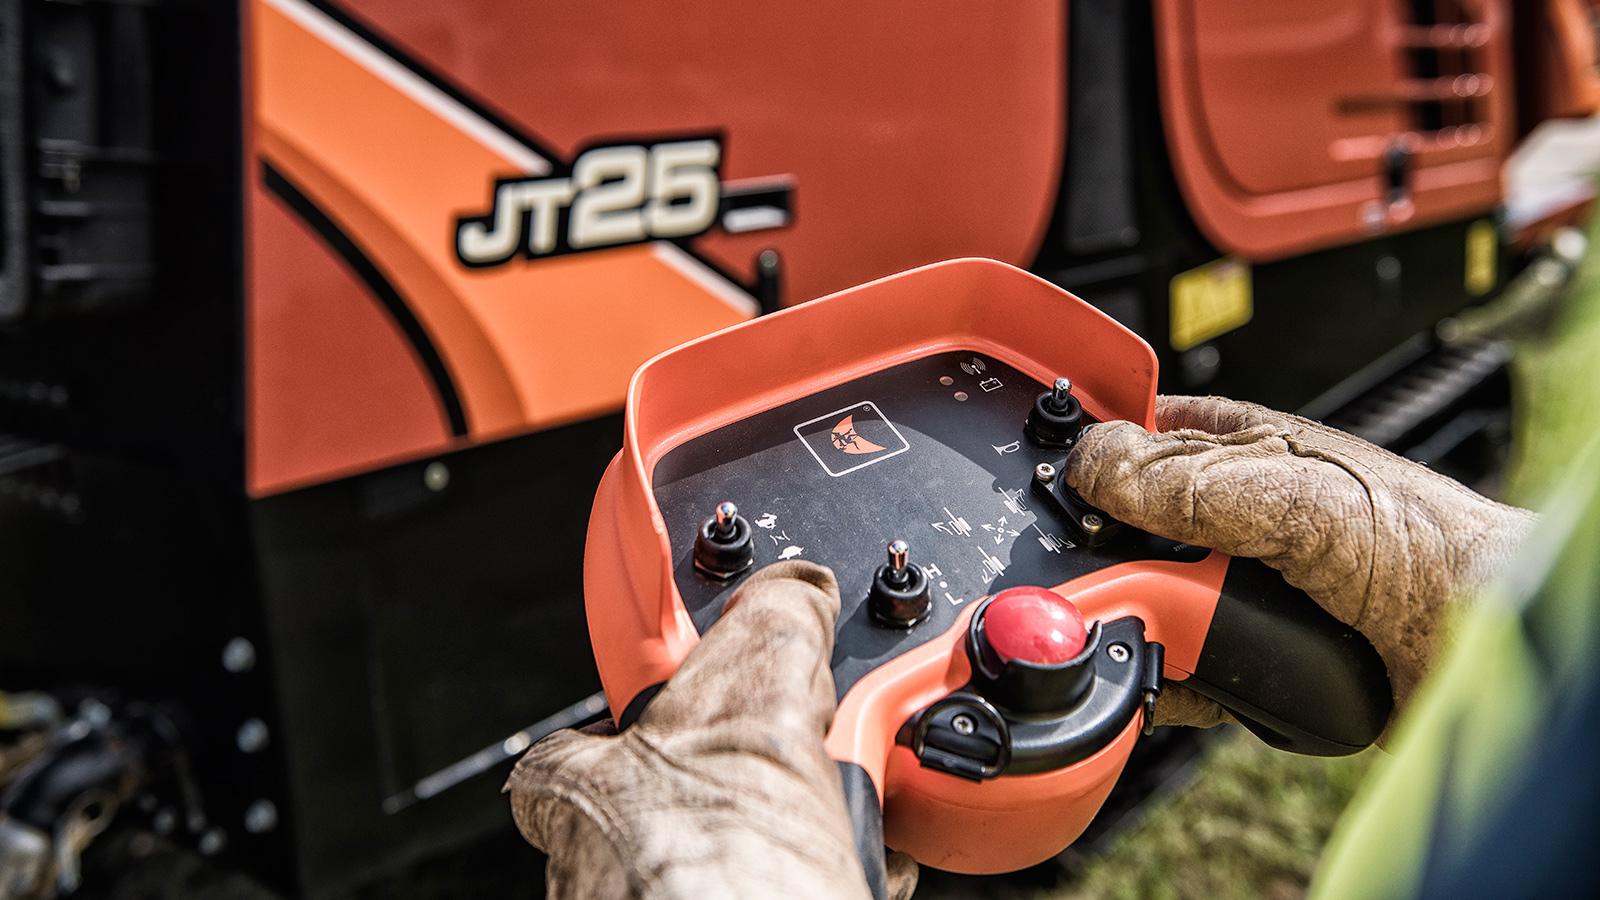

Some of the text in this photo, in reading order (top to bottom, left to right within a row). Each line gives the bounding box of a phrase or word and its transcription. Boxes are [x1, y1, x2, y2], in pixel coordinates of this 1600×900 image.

[457, 139, 721, 264] JT25
[922, 563, 943, 580] H
[944, 592, 964, 606] L
